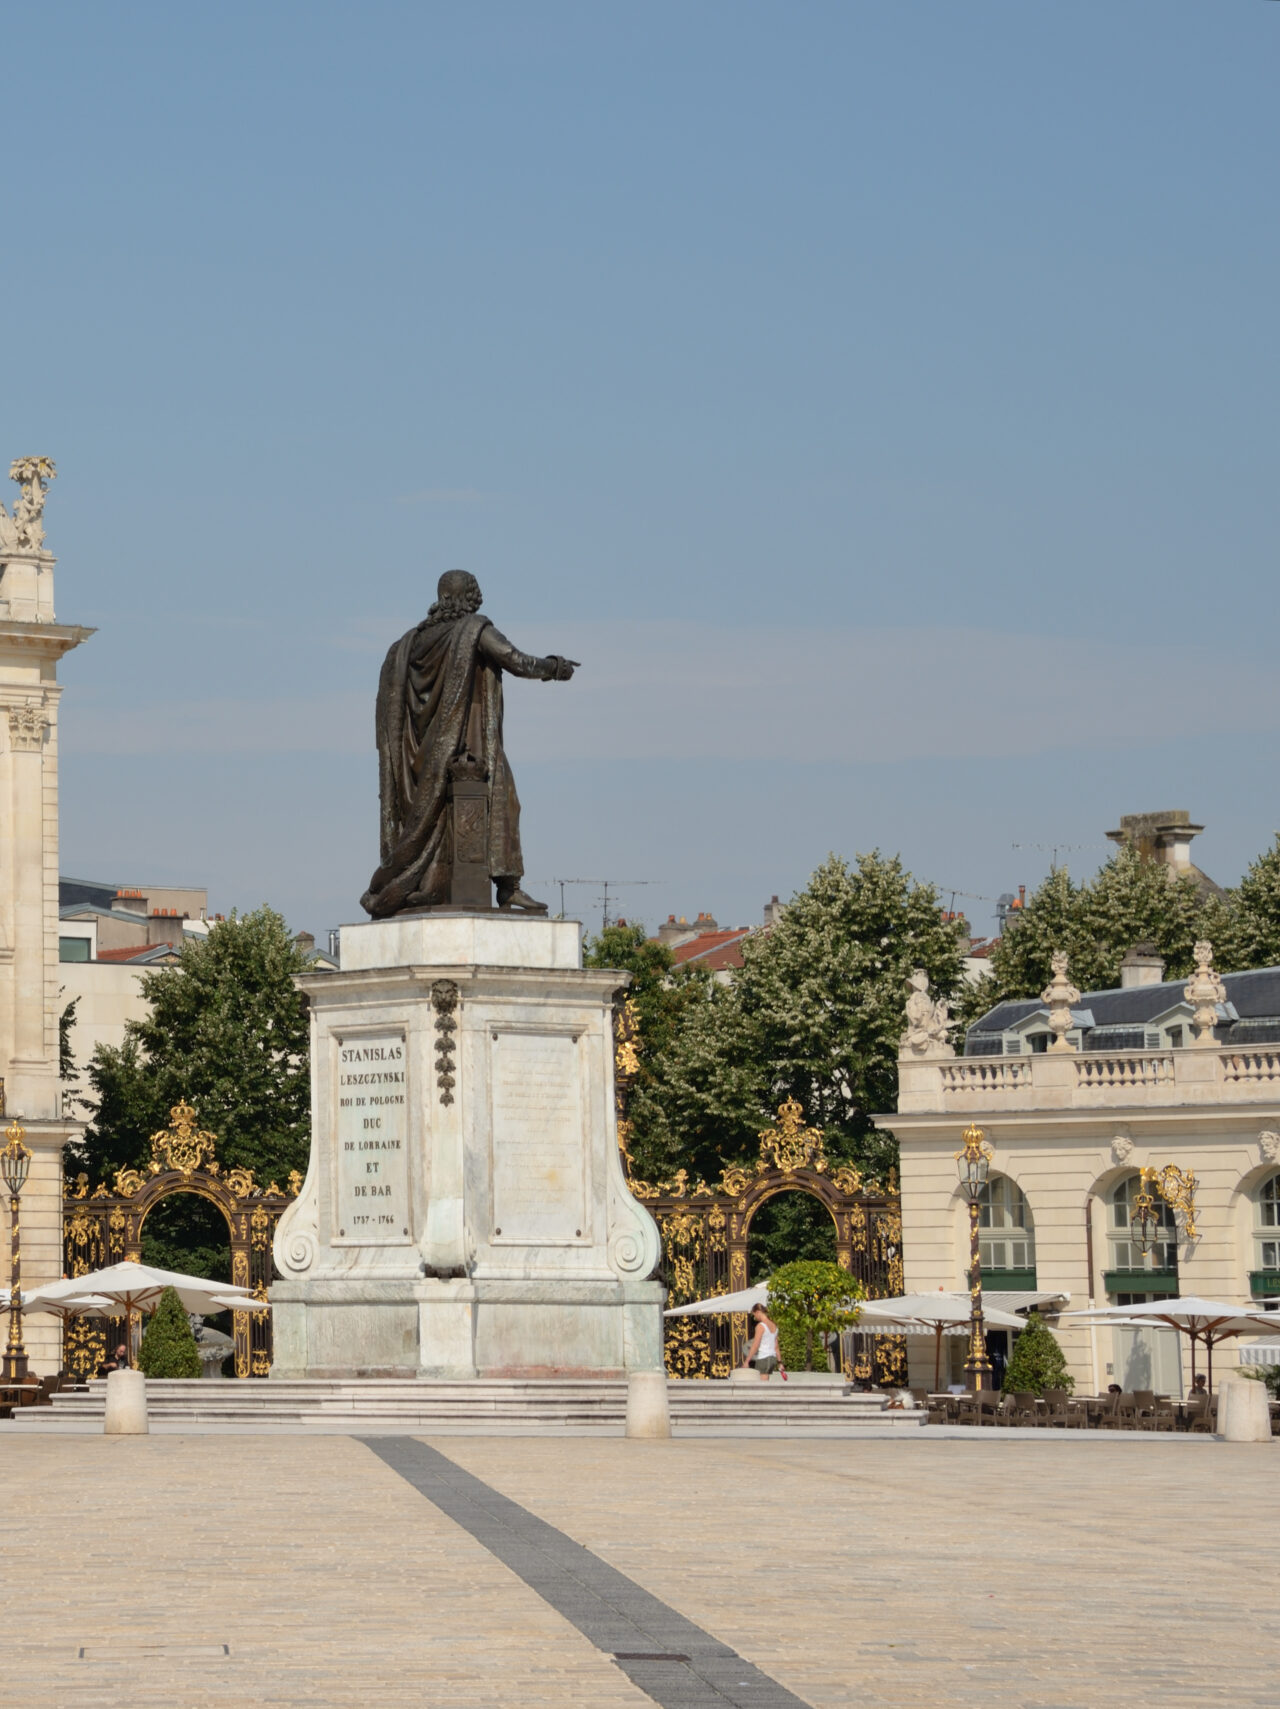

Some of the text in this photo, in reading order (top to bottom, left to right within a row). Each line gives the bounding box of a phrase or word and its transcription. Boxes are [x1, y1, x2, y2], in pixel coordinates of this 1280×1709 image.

[342, 1047, 402, 1063] STANISLAS
[340, 1072, 405, 1086] LESZCZYNSKI
[340, 1095, 404, 1107] ROI DE POLOGNE
[363, 1118, 381, 1129] DUC
[344, 1140, 401, 1151] DE LORRAINE
[366, 1162, 380, 1173] ET
[355, 1185, 391, 1197] DE BAR
[378, 1214, 394, 1224] 1766
